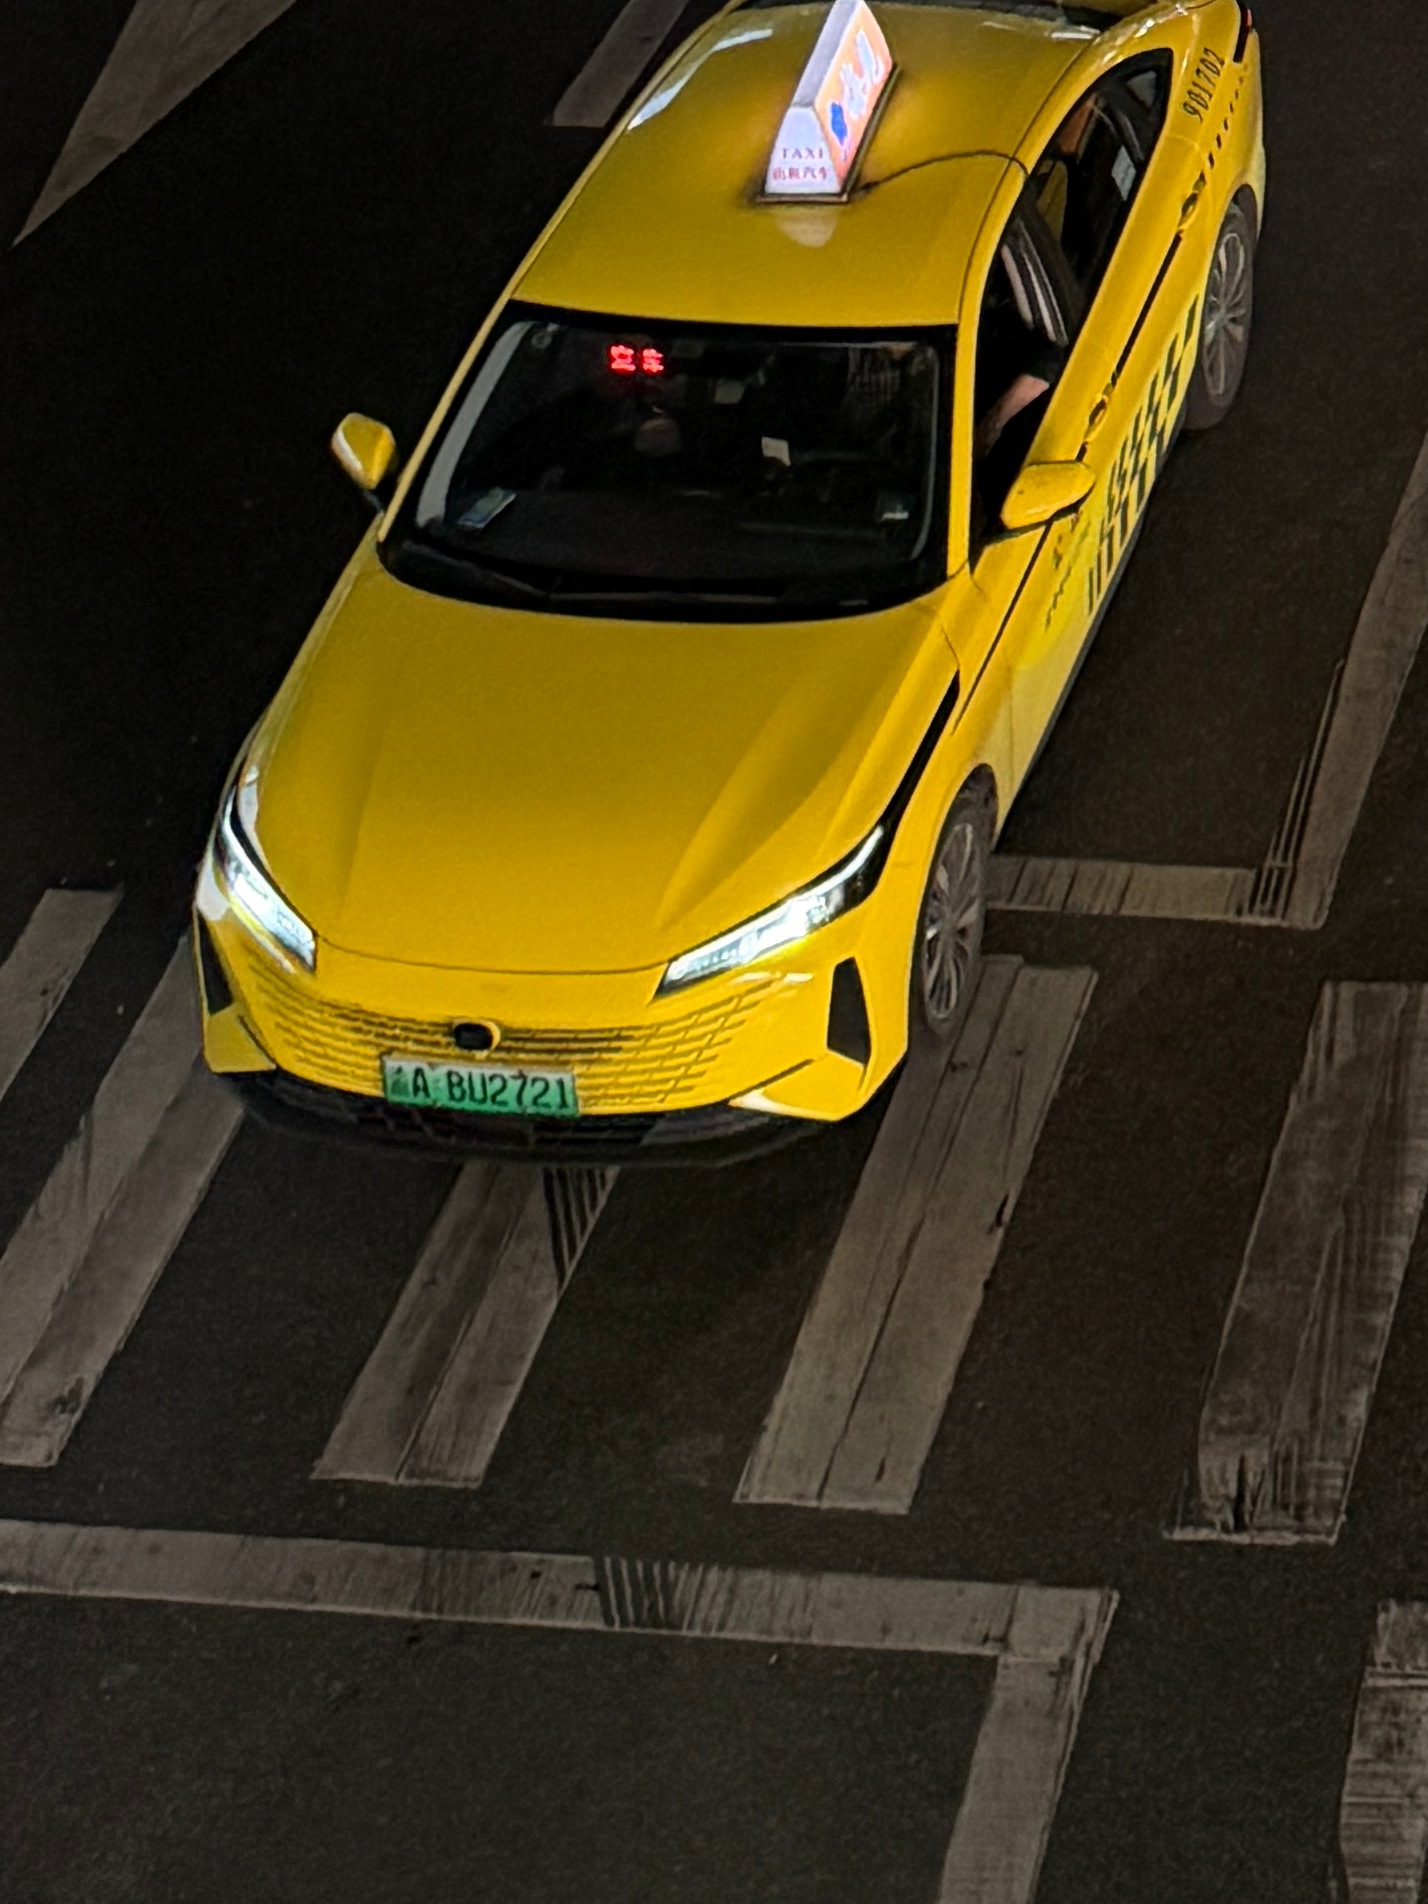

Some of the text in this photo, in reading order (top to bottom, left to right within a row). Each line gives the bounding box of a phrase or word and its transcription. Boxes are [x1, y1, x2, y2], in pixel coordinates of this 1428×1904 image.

[1182, 48, 1225, 122] 901702
[782, 147, 823, 160] TAXI
[446, 1071, 570, 1111] BU2721
